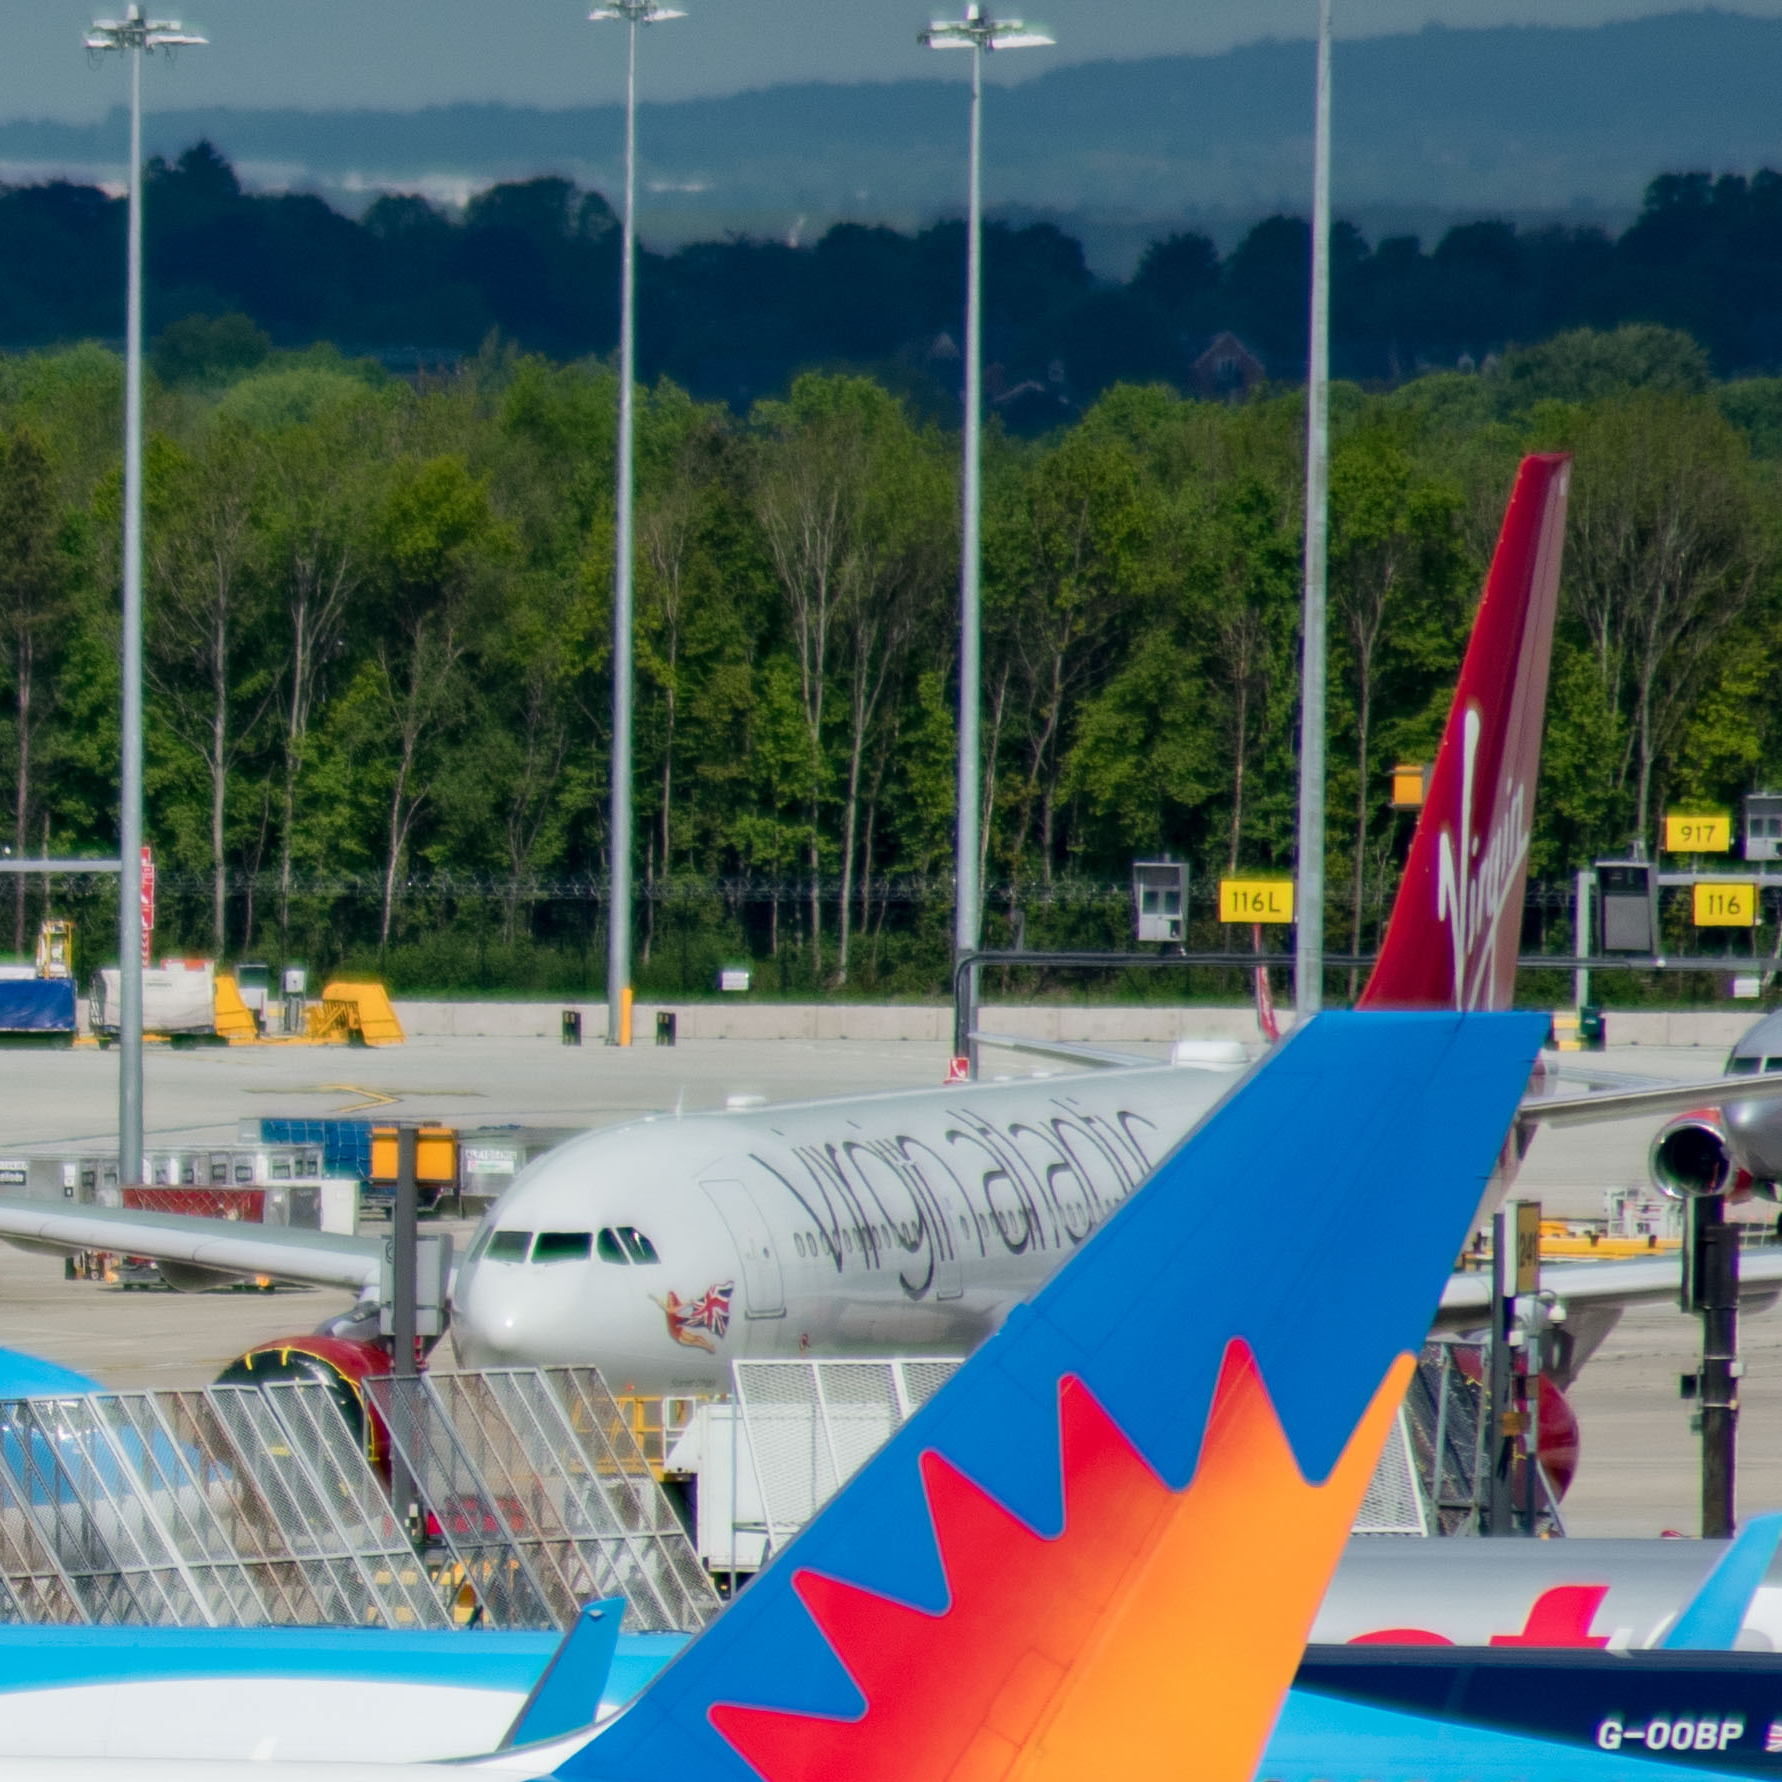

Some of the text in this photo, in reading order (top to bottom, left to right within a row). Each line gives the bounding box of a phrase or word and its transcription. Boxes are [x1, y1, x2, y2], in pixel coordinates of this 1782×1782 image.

[1680, 824, 1716, 843] 917
[1232, 890, 1282, 913] 116L
[1708, 893, 1741, 916] 116
[1596, 1719, 1745, 1751] G-OOBP
